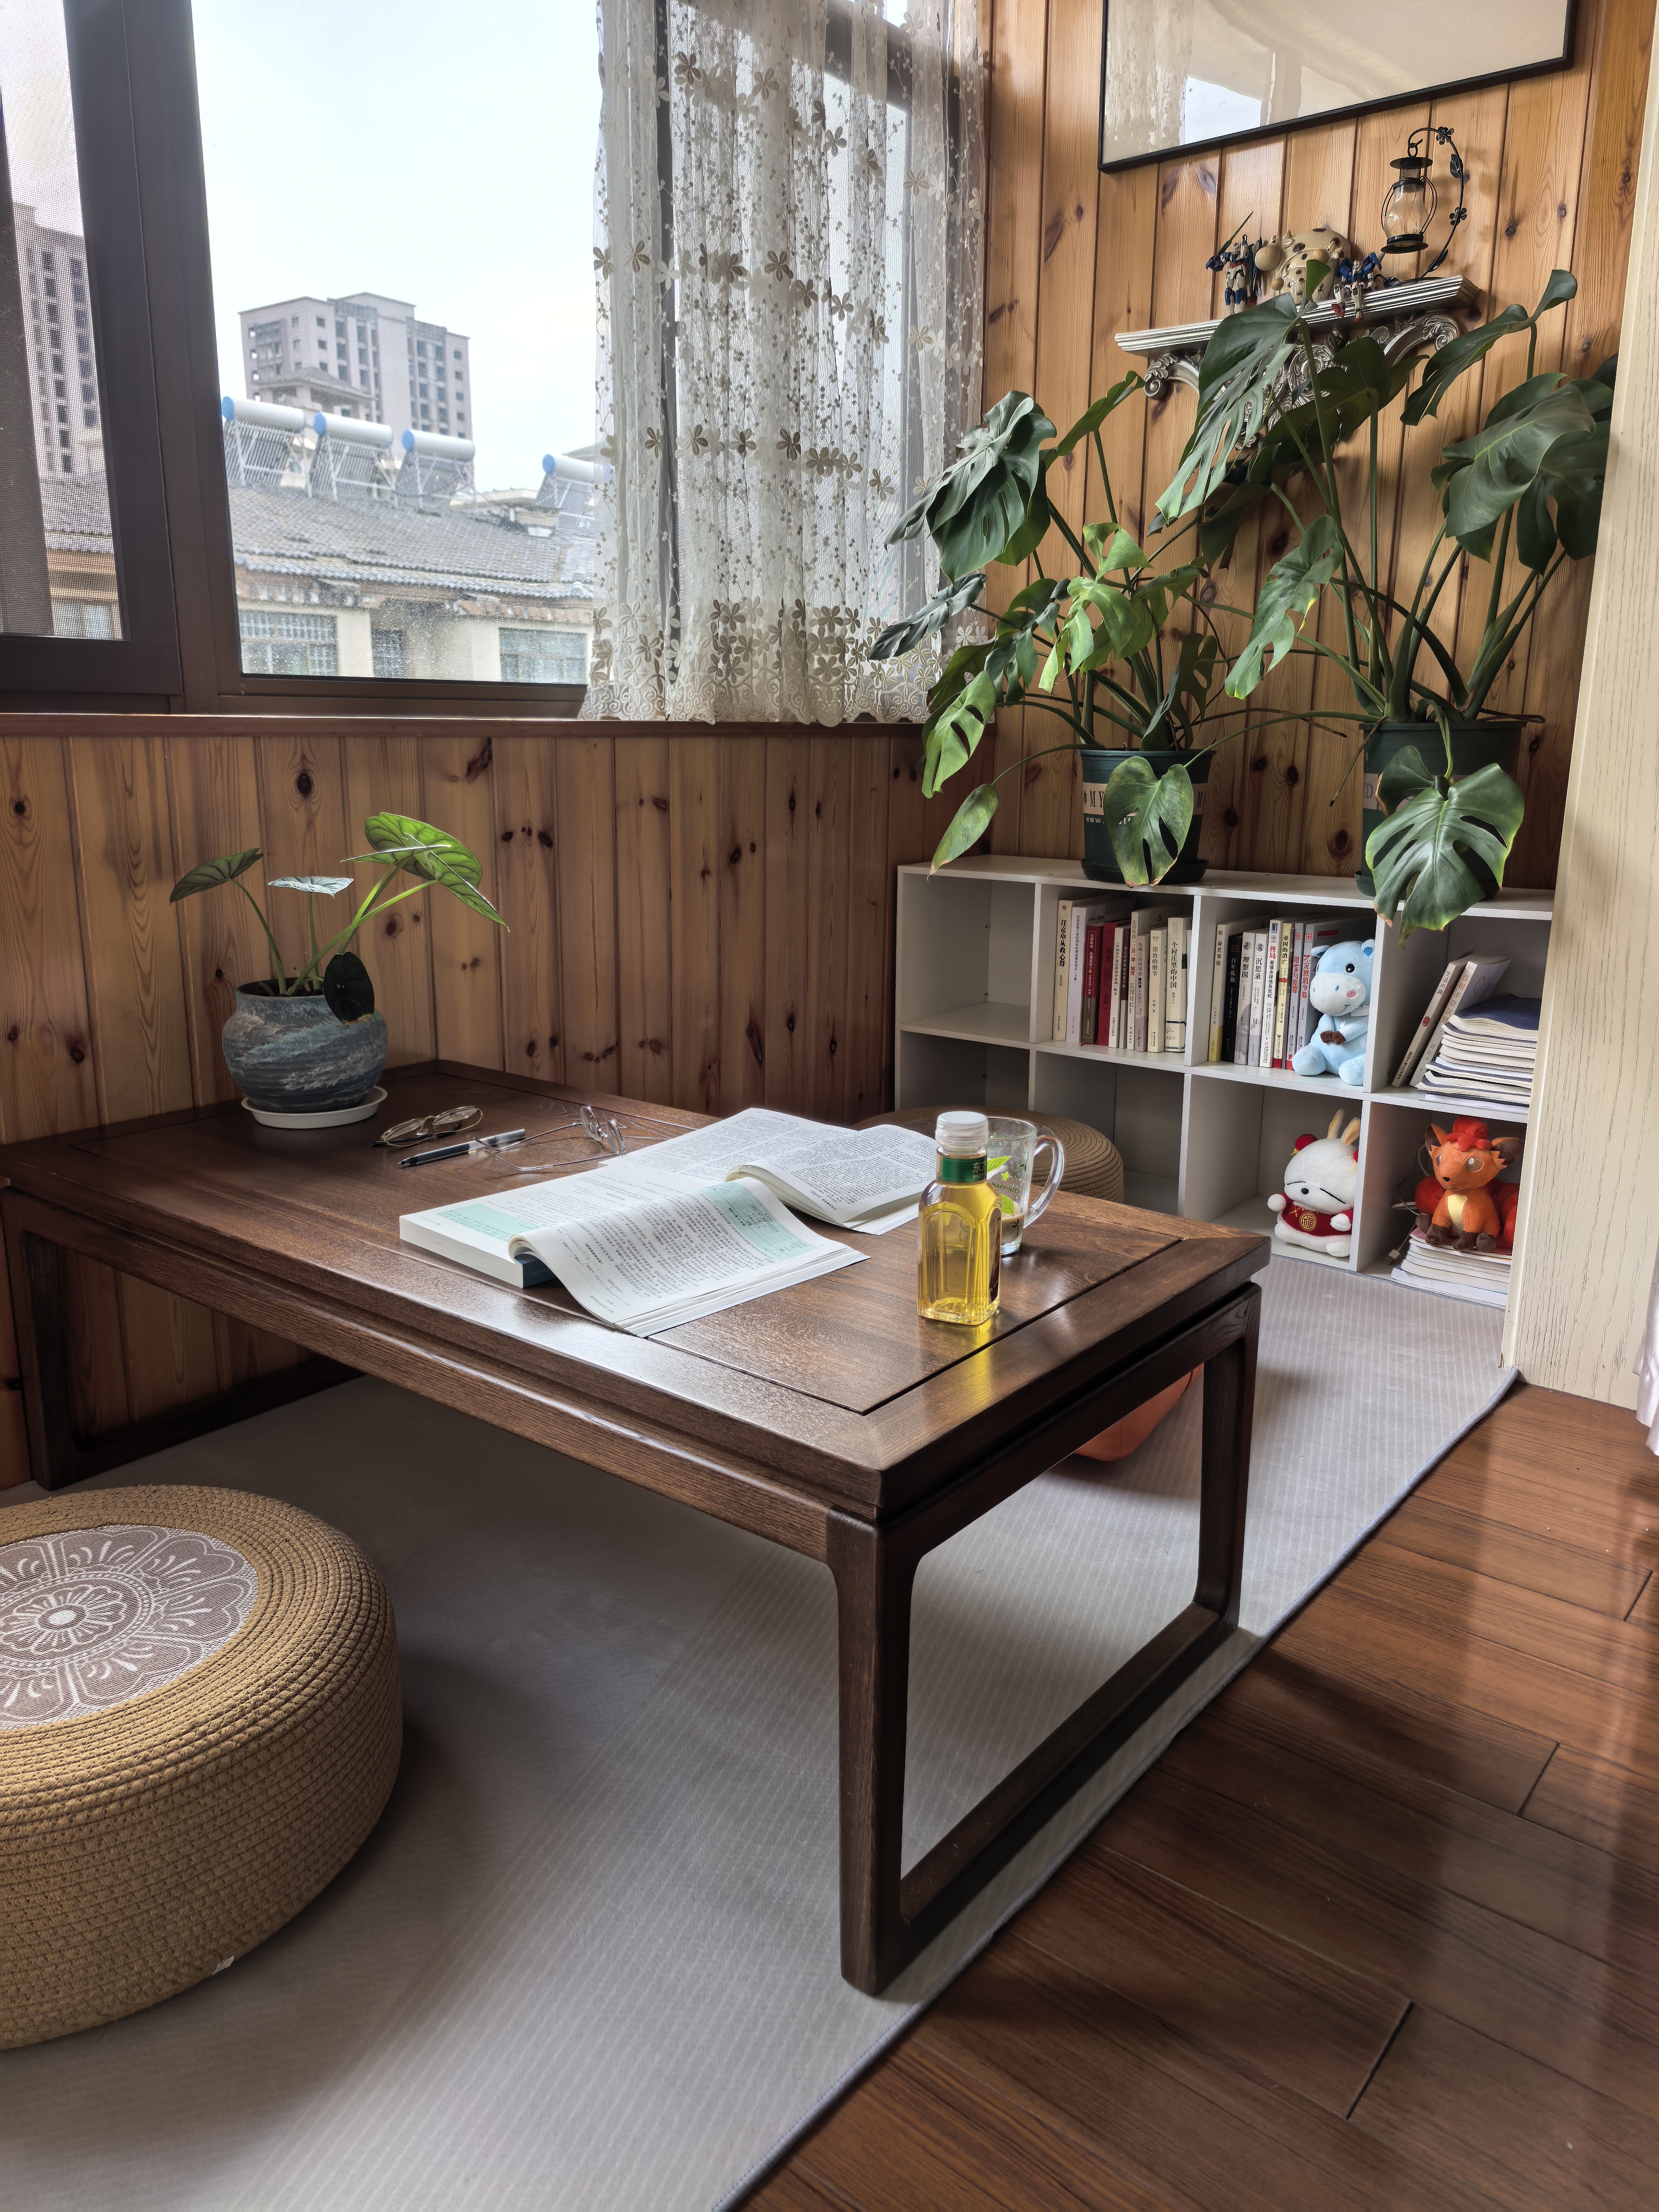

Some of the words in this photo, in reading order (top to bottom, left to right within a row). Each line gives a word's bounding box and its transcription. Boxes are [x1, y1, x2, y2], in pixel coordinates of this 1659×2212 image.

[1269, 946, 1276, 960] 终局
[1170, 937, 1178, 989] 一个村庄里的中国
[1255, 957, 1263, 980] 沉思录
[992, 1182, 1020, 1193] HAPPINESS
